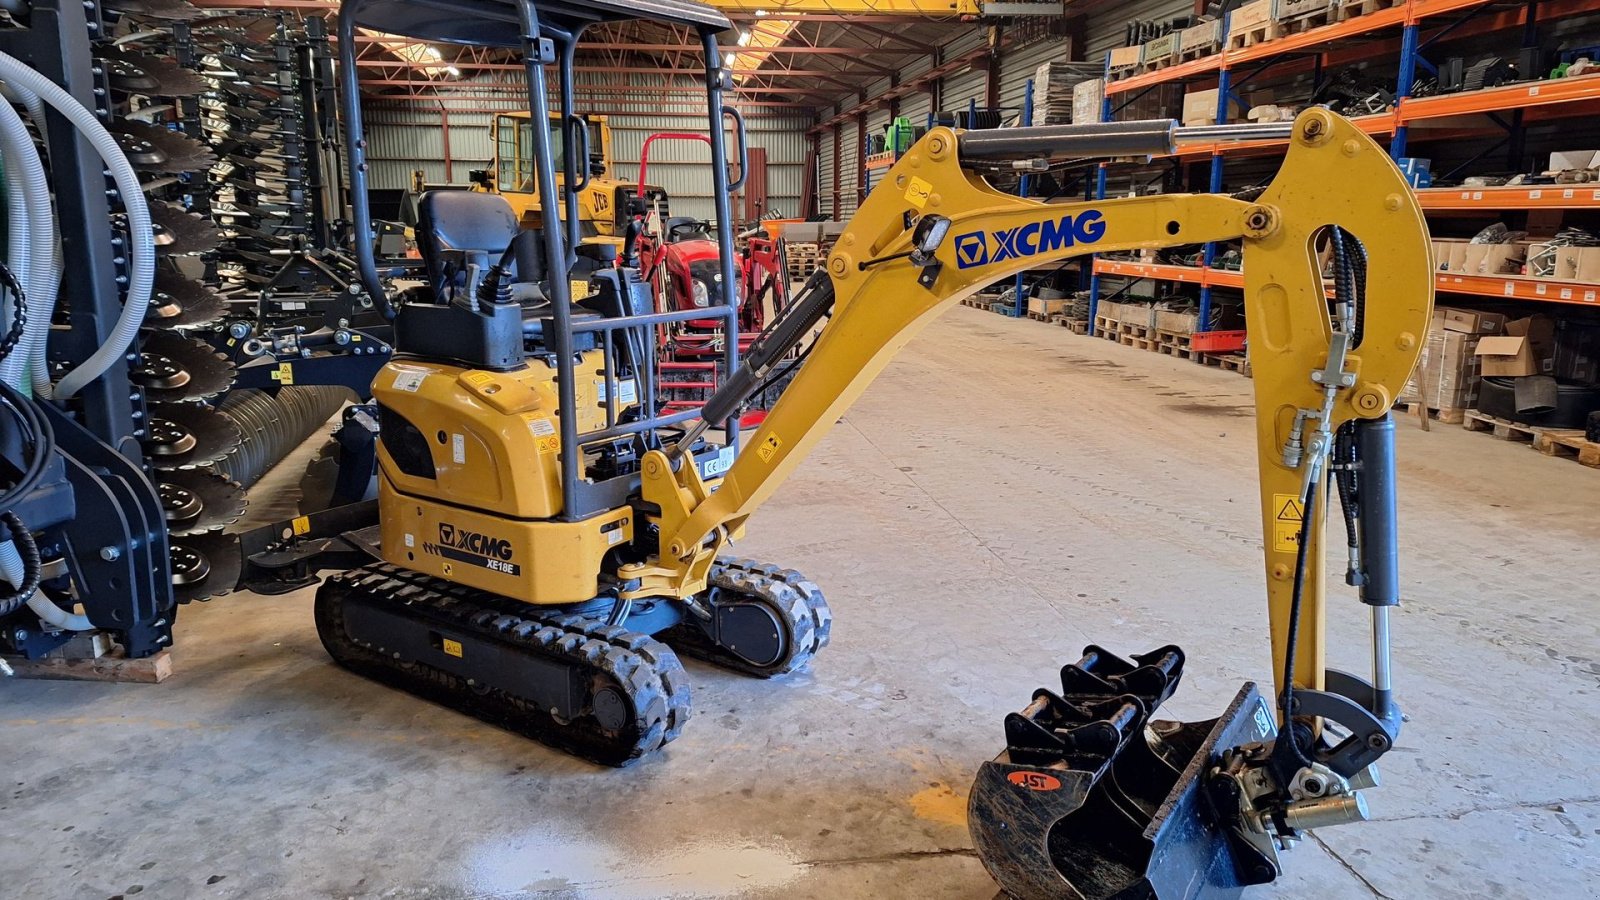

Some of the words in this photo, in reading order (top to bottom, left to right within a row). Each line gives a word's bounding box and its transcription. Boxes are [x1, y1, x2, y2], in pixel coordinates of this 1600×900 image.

[593, 191, 608, 213] JCB
[989, 209, 1106, 264] XCMG
[454, 529, 513, 561] XCMG
[486, 558, 514, 574] XE18E
